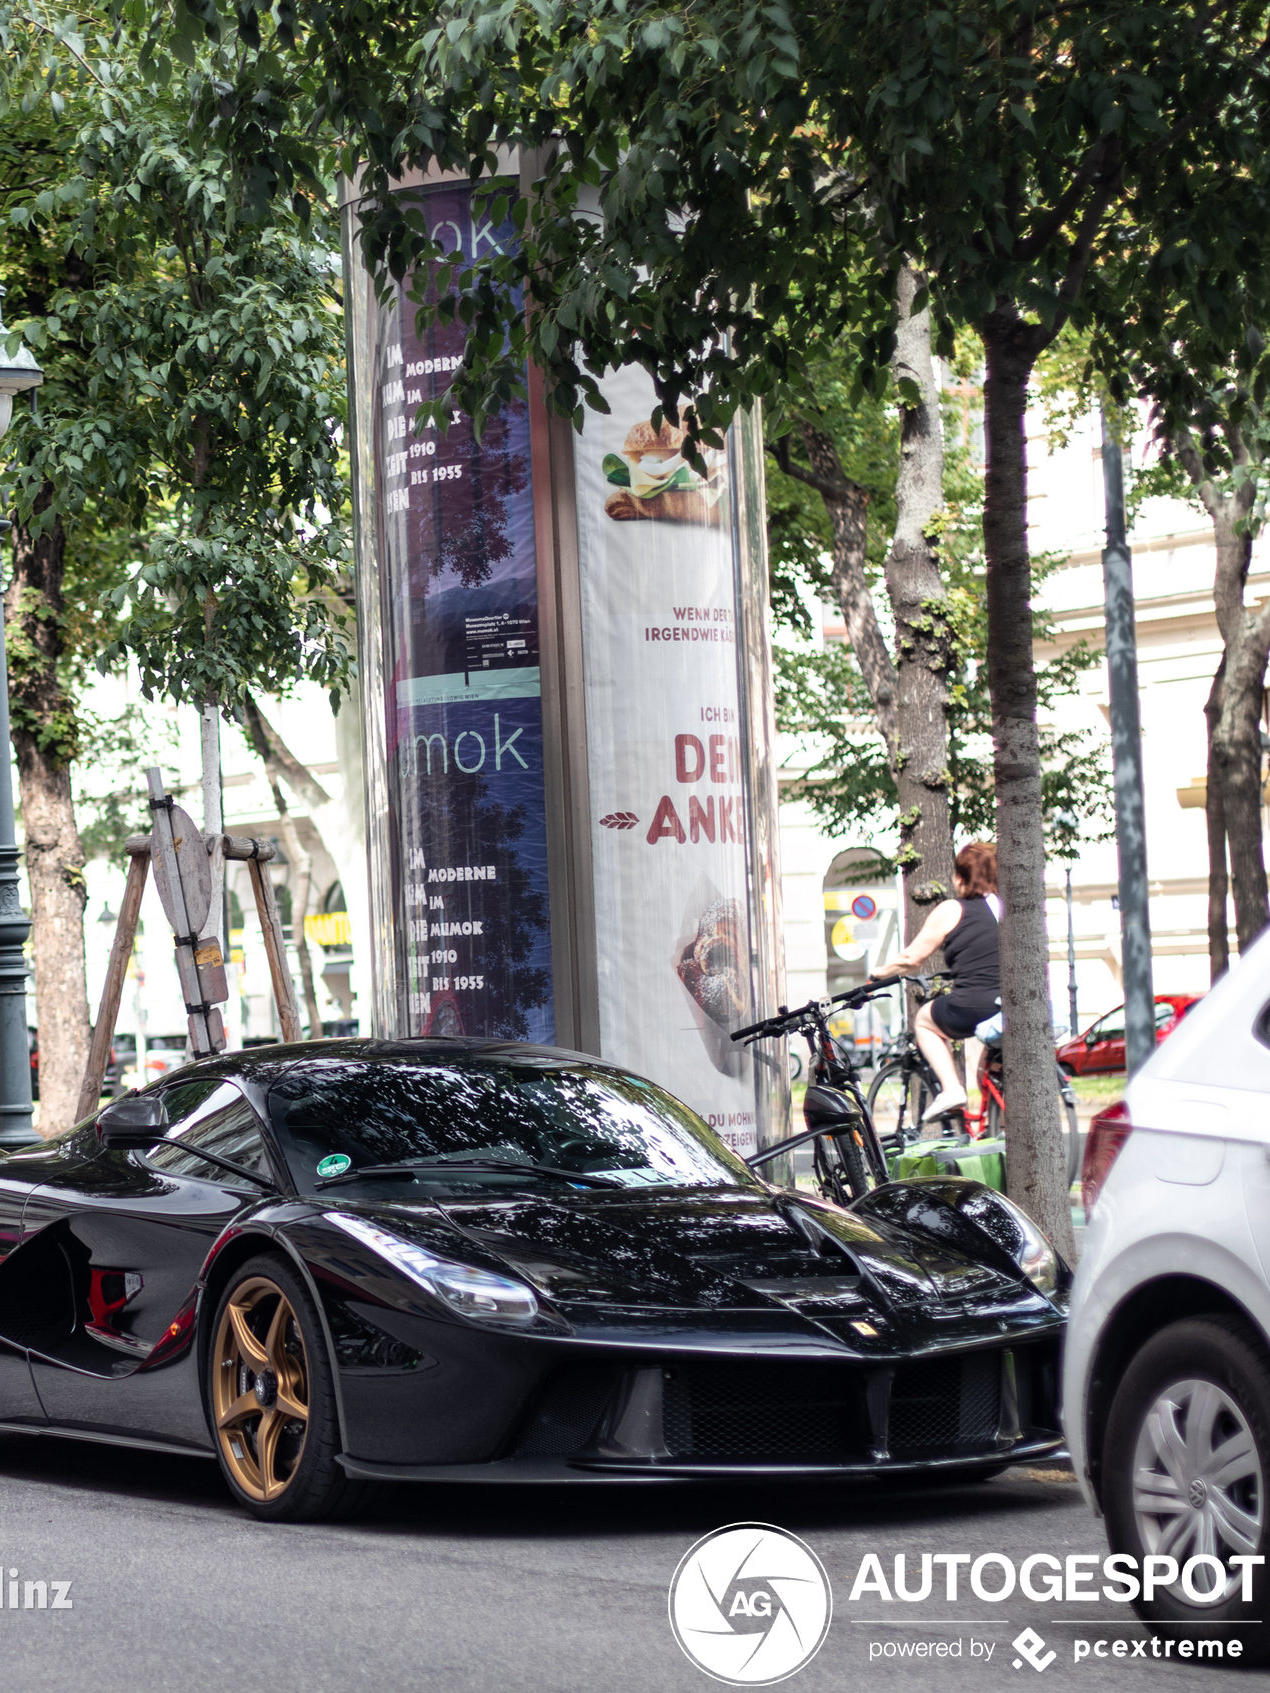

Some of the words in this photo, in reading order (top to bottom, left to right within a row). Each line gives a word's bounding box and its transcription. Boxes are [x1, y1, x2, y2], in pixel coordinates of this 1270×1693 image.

[407, 389, 423, 405] IM
[387, 415, 407, 441] DIE
[409, 441, 436, 458] 1910
[411, 469, 428, 485] BIS
[432, 465, 463, 482] 1955
[673, 606, 710, 621] WENN
[645, 627, 719, 642] IRGENDWIE
[700, 706, 721, 722] ICH
[428, 865, 497, 883] MODERNE
[429, 896, 445, 910] IM
[430, 921, 484, 937] MUMOK
[431, 949, 458, 964] 1910
[432, 977, 450, 991] BIS
[453, 975, 485, 990] 1955
[709, 1113, 725, 1128] DU
